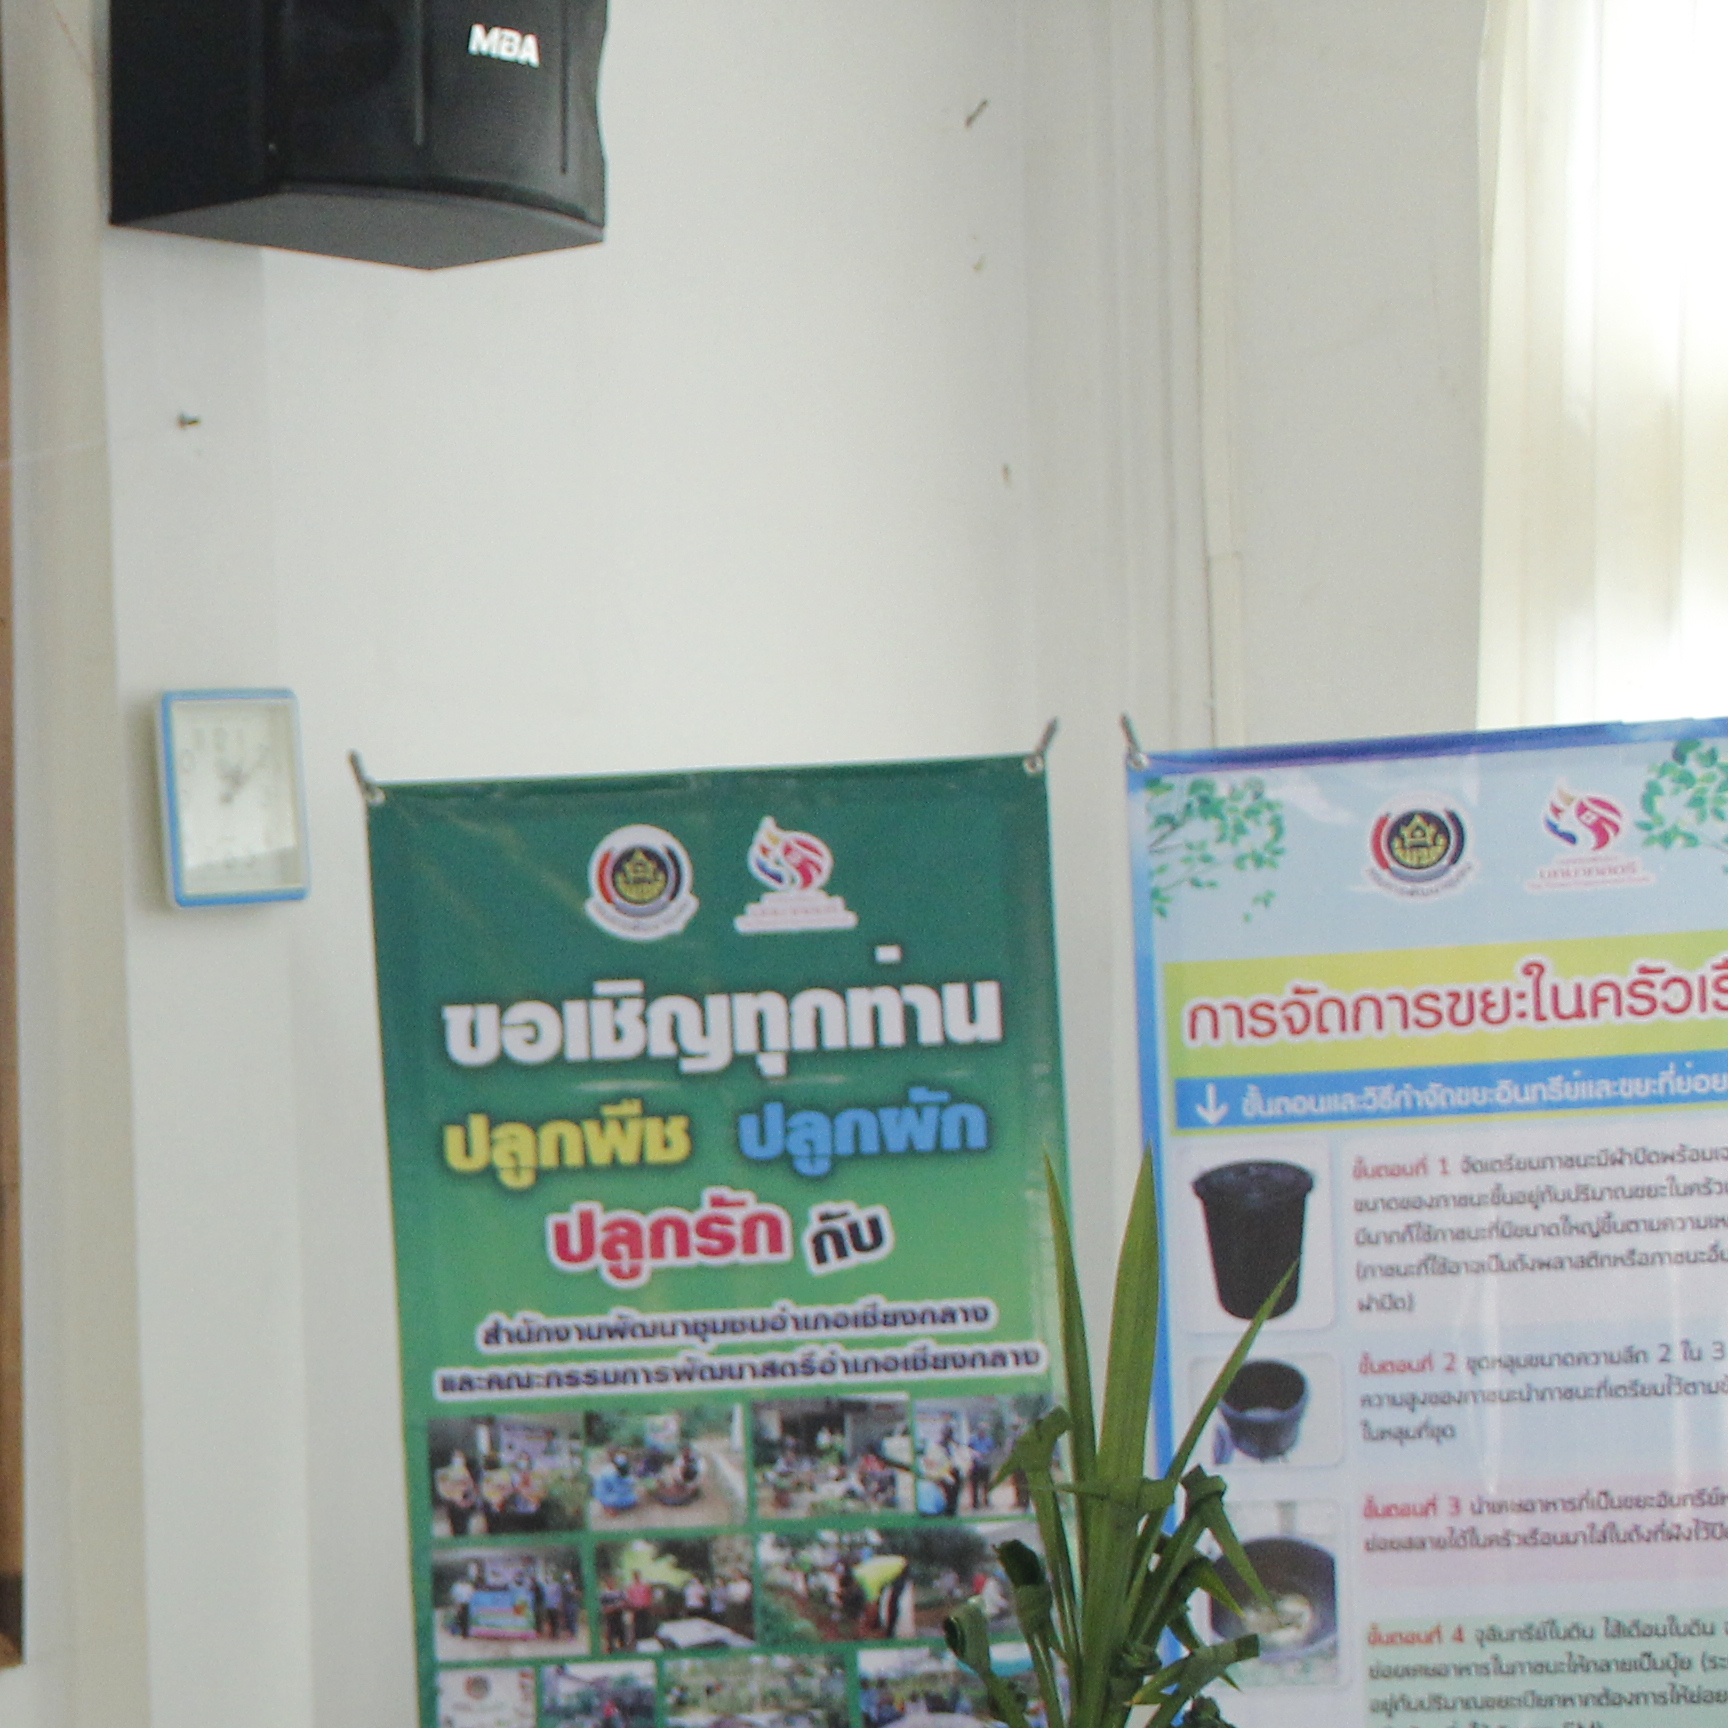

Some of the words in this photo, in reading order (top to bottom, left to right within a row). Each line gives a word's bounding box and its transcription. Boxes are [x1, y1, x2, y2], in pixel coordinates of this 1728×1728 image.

[468, 23, 541, 67] MBA
[443, 945, 1002, 1076] ขอเชิญทุกท่าน
[445, 1099, 689, 1189] ปลูกพืช
[740, 1087, 987, 1176] ปลูกผัก
[552, 1195, 786, 1278] ปลูกรัก
[812, 1212, 883, 1265] กับ
[1658, 1343, 1672, 1363] 2
[1711, 1341, 1726, 1361] 3
